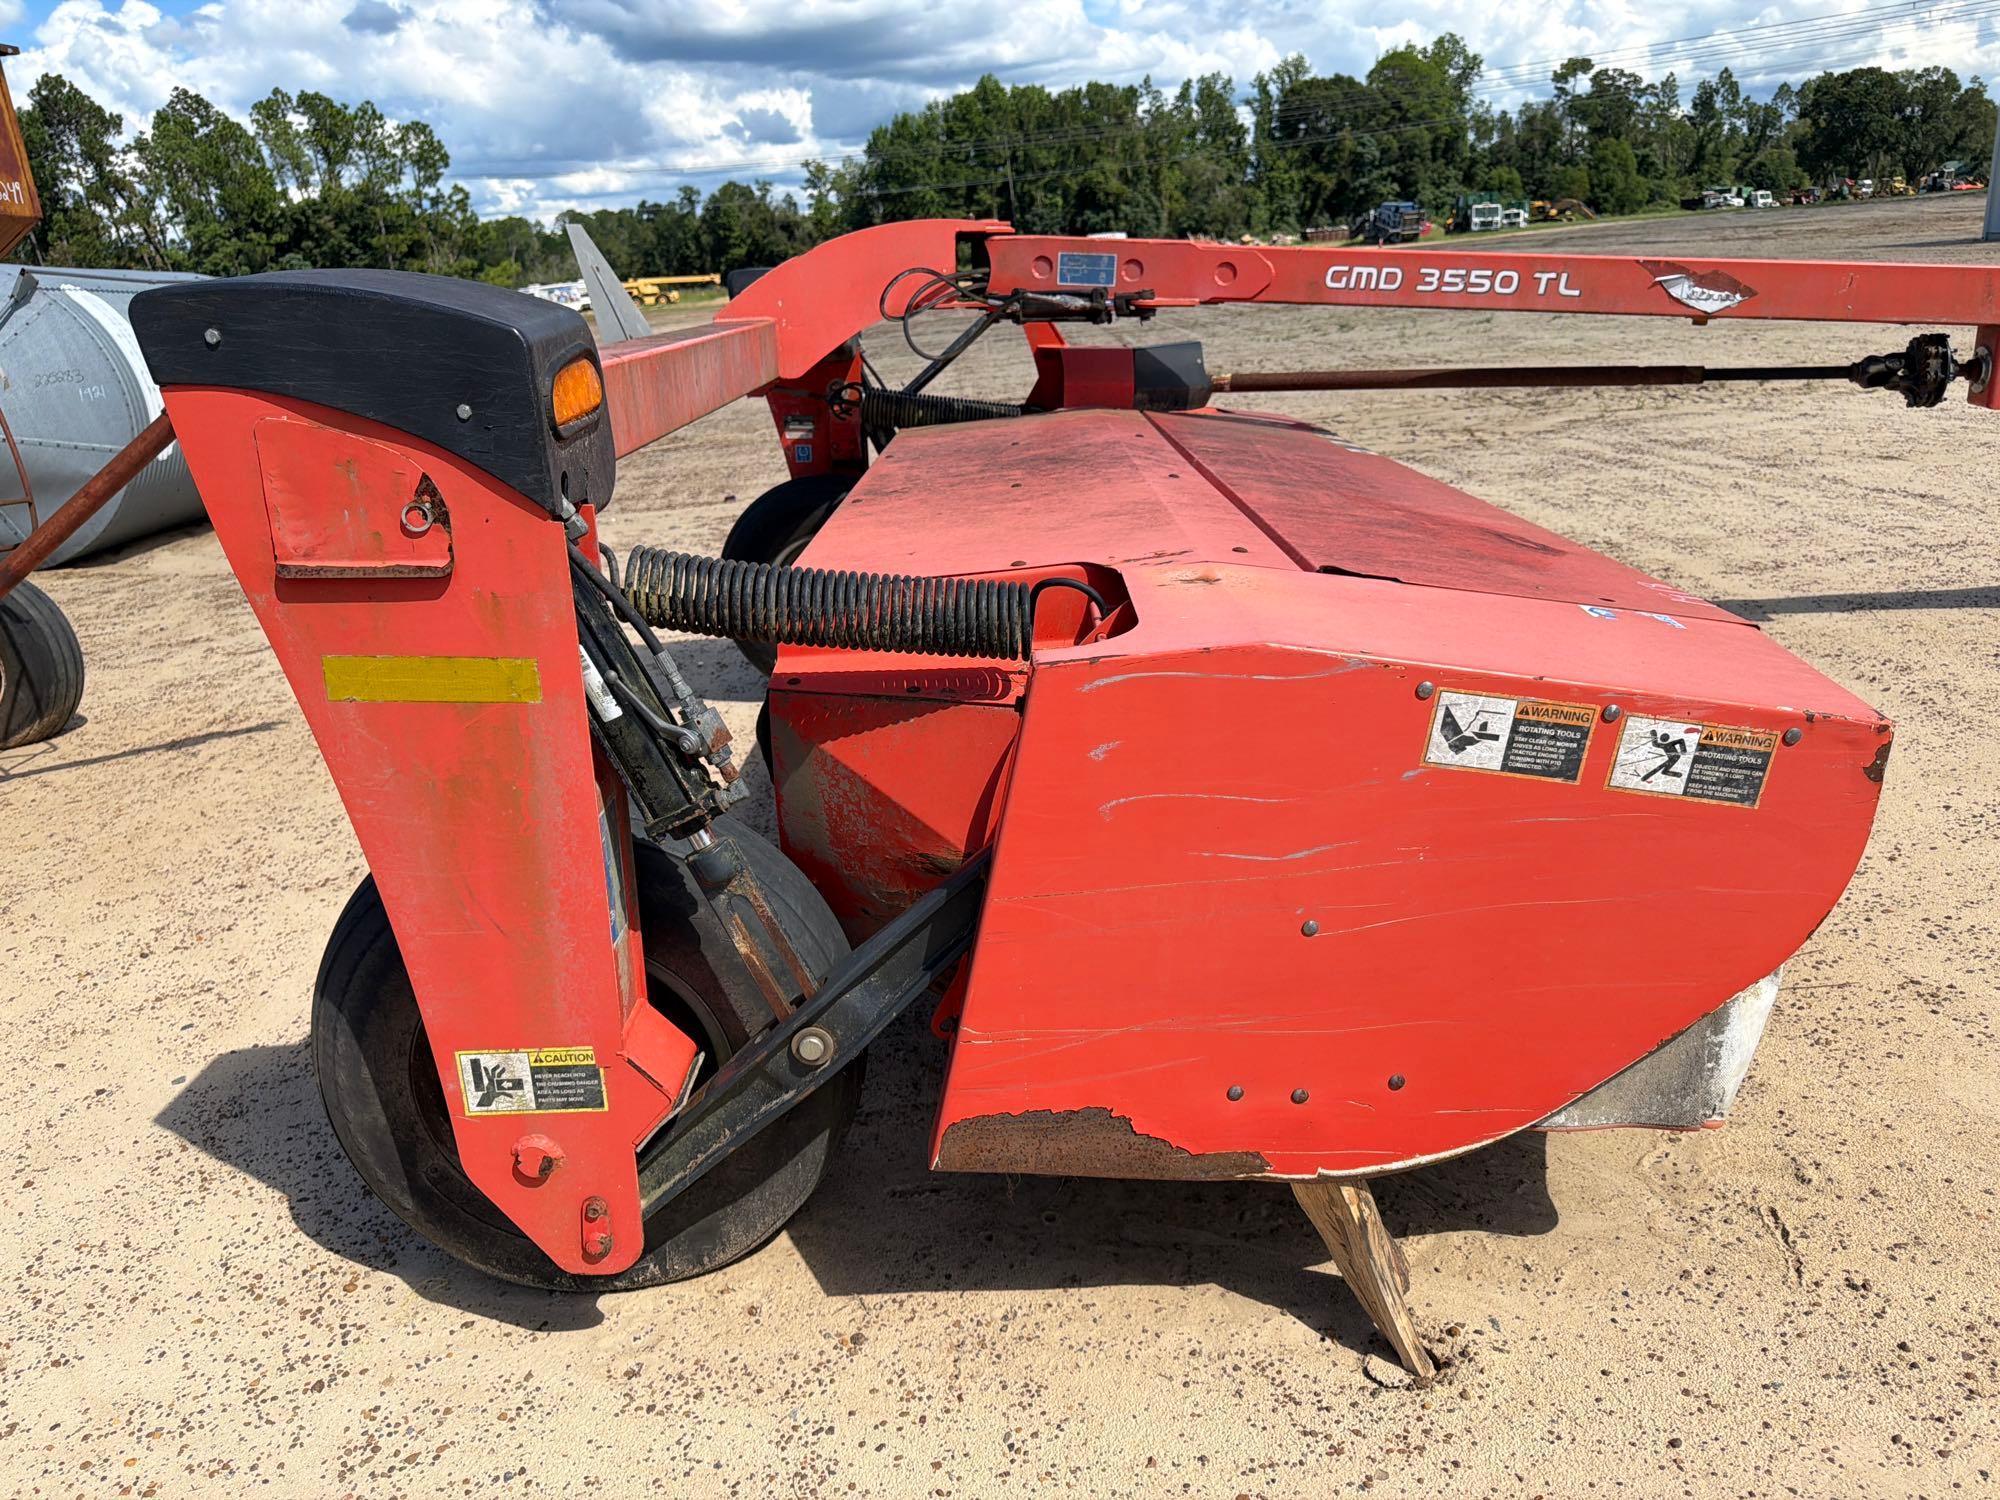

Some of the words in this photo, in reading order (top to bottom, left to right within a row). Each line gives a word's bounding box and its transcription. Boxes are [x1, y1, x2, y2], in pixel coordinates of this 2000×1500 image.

[1325, 266, 1402, 290] GMD
[1416, 268, 1519, 294] 3550
[1533, 272, 1581, 296] TL
[1532, 707, 1590, 722] WARNING
[1519, 726, 1555, 735] ROTATING
[1557, 730, 1581, 738] TOOLS
[1716, 732, 1772, 747] WARNING
[1702, 752, 1737, 761] ROTATING
[1739, 755, 1761, 764] TOOLS
[545, 1054, 593, 1062] CAUTION
